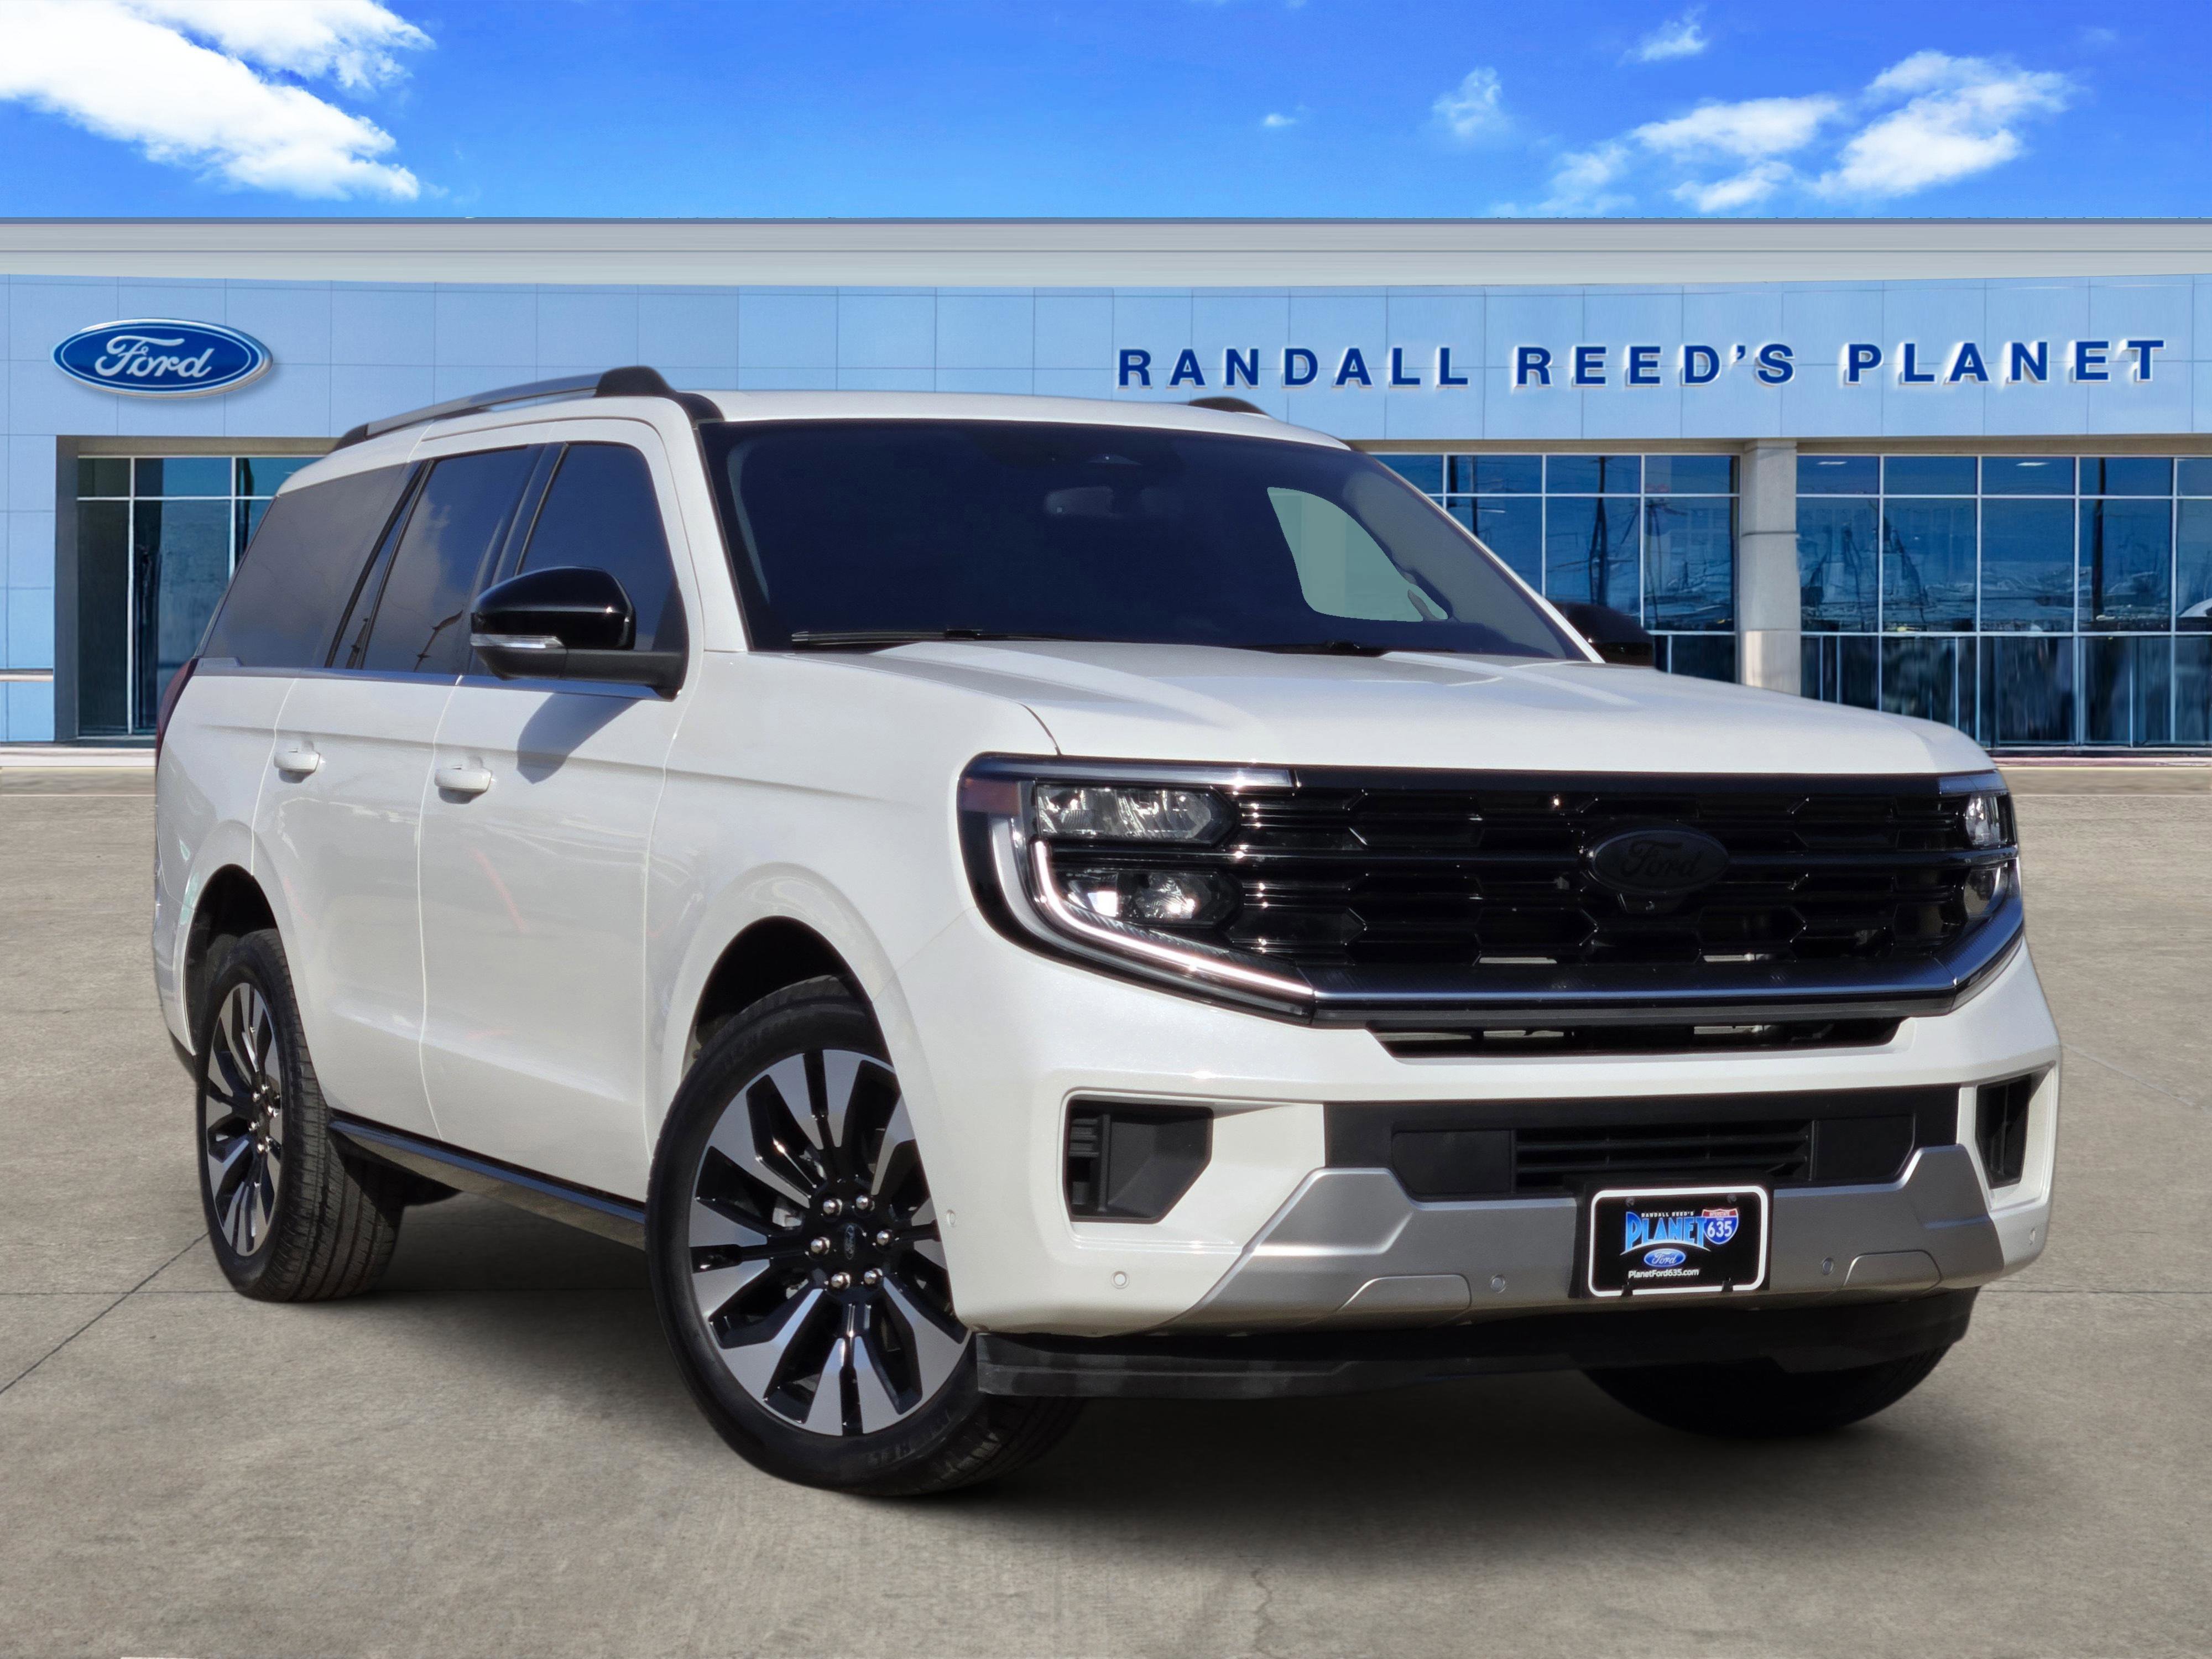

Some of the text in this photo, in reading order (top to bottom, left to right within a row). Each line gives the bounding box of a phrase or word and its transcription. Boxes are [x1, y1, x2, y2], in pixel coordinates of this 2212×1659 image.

[95, 335, 215, 378] Ford
[1117, 339, 2166, 387] RANDALL REED'S PLANET
[1620, 839, 1702, 878] Ford
[1625, 1211, 1707, 1252] PLANET
[1707, 1220, 1733, 1238] 635
[1628, 1269, 1699, 1279] PlanetFord635.com
[1651, 1251, 1678, 1265] Ford
